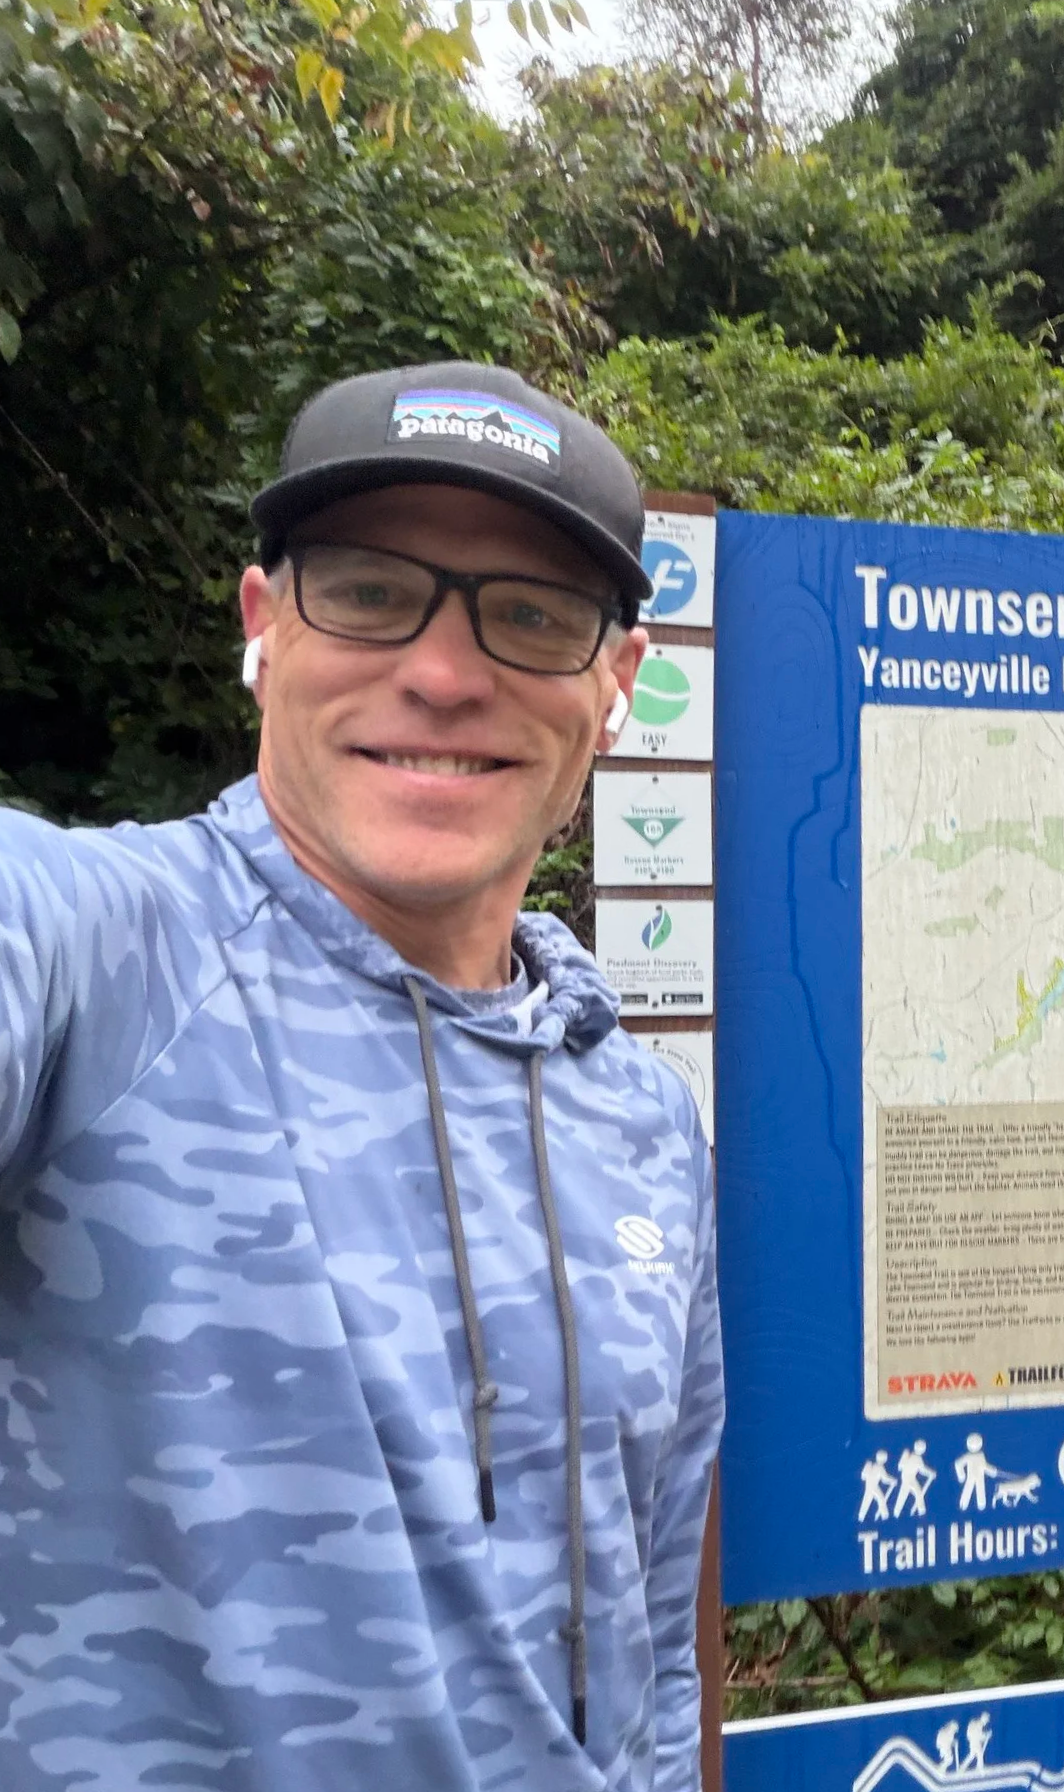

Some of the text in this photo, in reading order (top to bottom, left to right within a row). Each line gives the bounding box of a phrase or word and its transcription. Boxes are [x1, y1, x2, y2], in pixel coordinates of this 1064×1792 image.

[398, 417, 549, 465] patagonia
[858, 645, 1050, 698] Yanceyville
[642, 733, 668, 746] EASY
[887, 1371, 977, 1394] STRAVA
[857, 1524, 937, 1574] Trail
[949, 1521, 1058, 1566] Hours:
